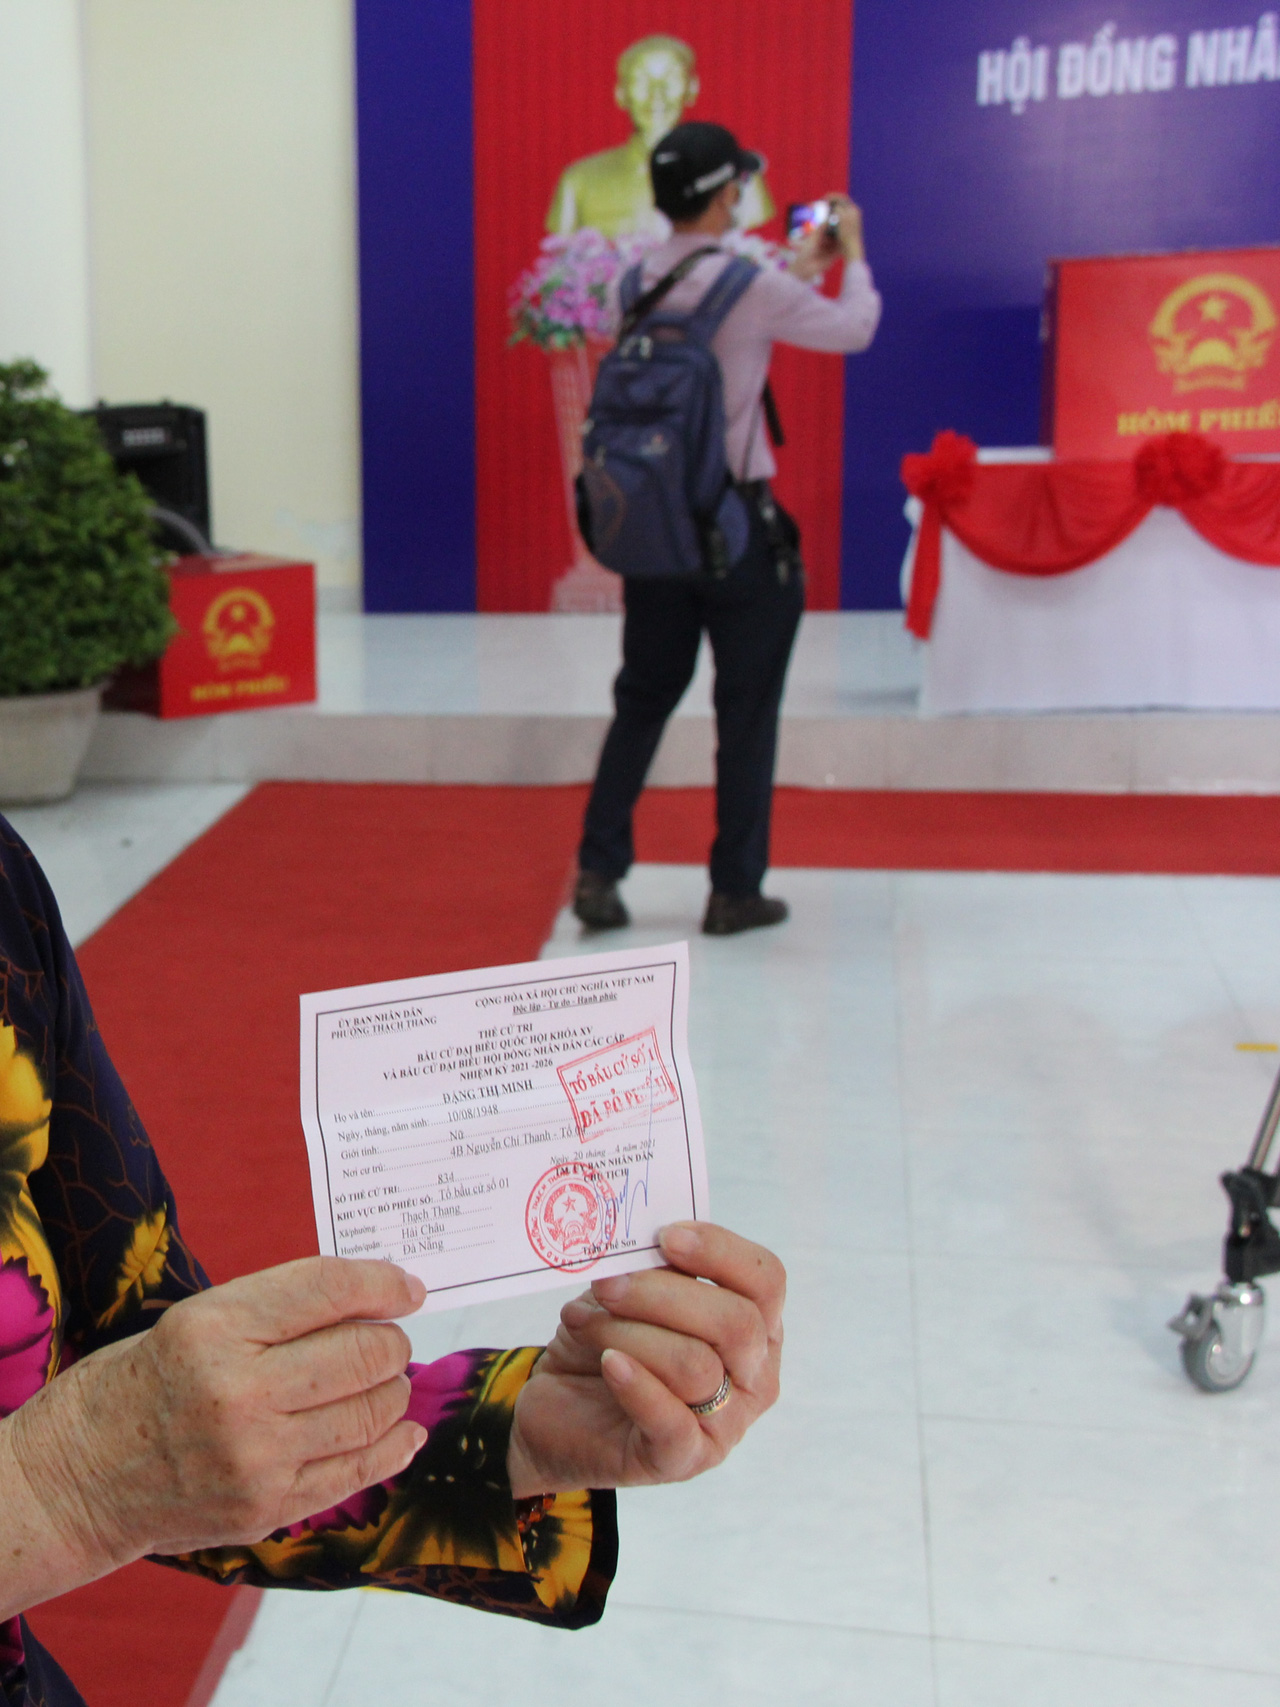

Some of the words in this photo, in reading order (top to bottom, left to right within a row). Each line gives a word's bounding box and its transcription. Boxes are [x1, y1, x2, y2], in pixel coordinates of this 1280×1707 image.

[976, 36, 1050, 115] HỘI
[1186, 11, 1280, 89] NHÂ
[1200, 399, 1280, 433] PHIẾ
[475, 996, 502, 1009] CỘNG
[504, 991, 523, 1003] HÒA
[540, 986, 557, 999] HỘI
[559, 984, 579, 996] CHỦ
[580, 979, 609, 993] NGHĨA
[612, 977, 632, 988] VIỆT
[634, 974, 655, 984] NAM
[513, 1003, 528, 1014] Độc
[529, 1002, 541, 1012] lập
[560, 998, 570, 1008] do
[577, 993, 598, 1007] Hạnh
[599, 991, 618, 1003] phúc
[353, 1014, 372, 1026] BAN
[375, 1009, 402, 1023] NHÂN
[403, 1007, 423, 1019] DÂN
[331, 1026, 370, 1040] PHƯỜNG
[406, 1015, 437, 1029] THANG
[517, 1022, 533, 1033] TRI
[456, 1044, 473, 1058] ĐẠI
[530, 1032, 548, 1045] HỘI
[579, 1025, 594, 1036] XV
[439, 1058, 456, 1073] ĐẠI
[483, 1050, 501, 1064] HỘI
[533, 1041, 560, 1055] NHÂN
[562, 1038, 582, 1051] DÂN
[584, 1035, 604, 1048] CÁC
[459, 1067, 492, 1082] NHIỆM
[510, 1060, 529, 1072] 2021
[477, 1086, 499, 1099] THỊ
[501, 1079, 534, 1096] MINH
[569, 1070, 588, 1095] TỔ
[334, 1112, 347, 1124] Họ
[349, 1110, 359, 1121] và
[360, 1108, 376, 1118] tên:
[447, 1104, 499, 1123] 10/08/1948
[579, 1101, 603, 1129] ĐÃ
[338, 1128, 363, 1143] Ngày,
[364, 1123, 390, 1136] tháng,
[391, 1121, 409, 1132] năm
[411, 1118, 430, 1129] sinh:
[449, 1130, 465, 1142] Nữ
[450, 1144, 463, 1157] 4B
[465, 1137, 501, 1156] Nguyễn
[503, 1134, 520, 1150] Chí
[523, 1128, 552, 1146] Thanh
[574, 1152, 584, 1161] 20
[585, 1148, 606, 1159] tháng
[622, 1142, 638, 1152] năm
[340, 1148, 360, 1160] Giới
[361, 1145, 379, 1157] tính:
[608, 1153, 634, 1167] NHÂN
[635, 1151, 654, 1162] DÂN
[342, 1166, 359, 1179] Nơi
[360, 1165, 371, 1176] cư
[372, 1162, 387, 1173] trú:
[437, 1172, 455, 1185] 834
[605, 1167, 628, 1181] TỊCH
[383, 1185, 401, 1195] TRI:
[439, 1188, 452, 1202] Tổ
[498, 1177, 510, 1189] 01
[336, 1210, 356, 1222] KHU
[358, 1206, 376, 1219] VỰC
[400, 1208, 429, 1225] Thạch
[431, 1203, 461, 1219] Thang
[420, 1221, 445, 1236] Châu
[403, 1243, 417, 1256] Đà
[621, 1238, 637, 1249] Sơn
